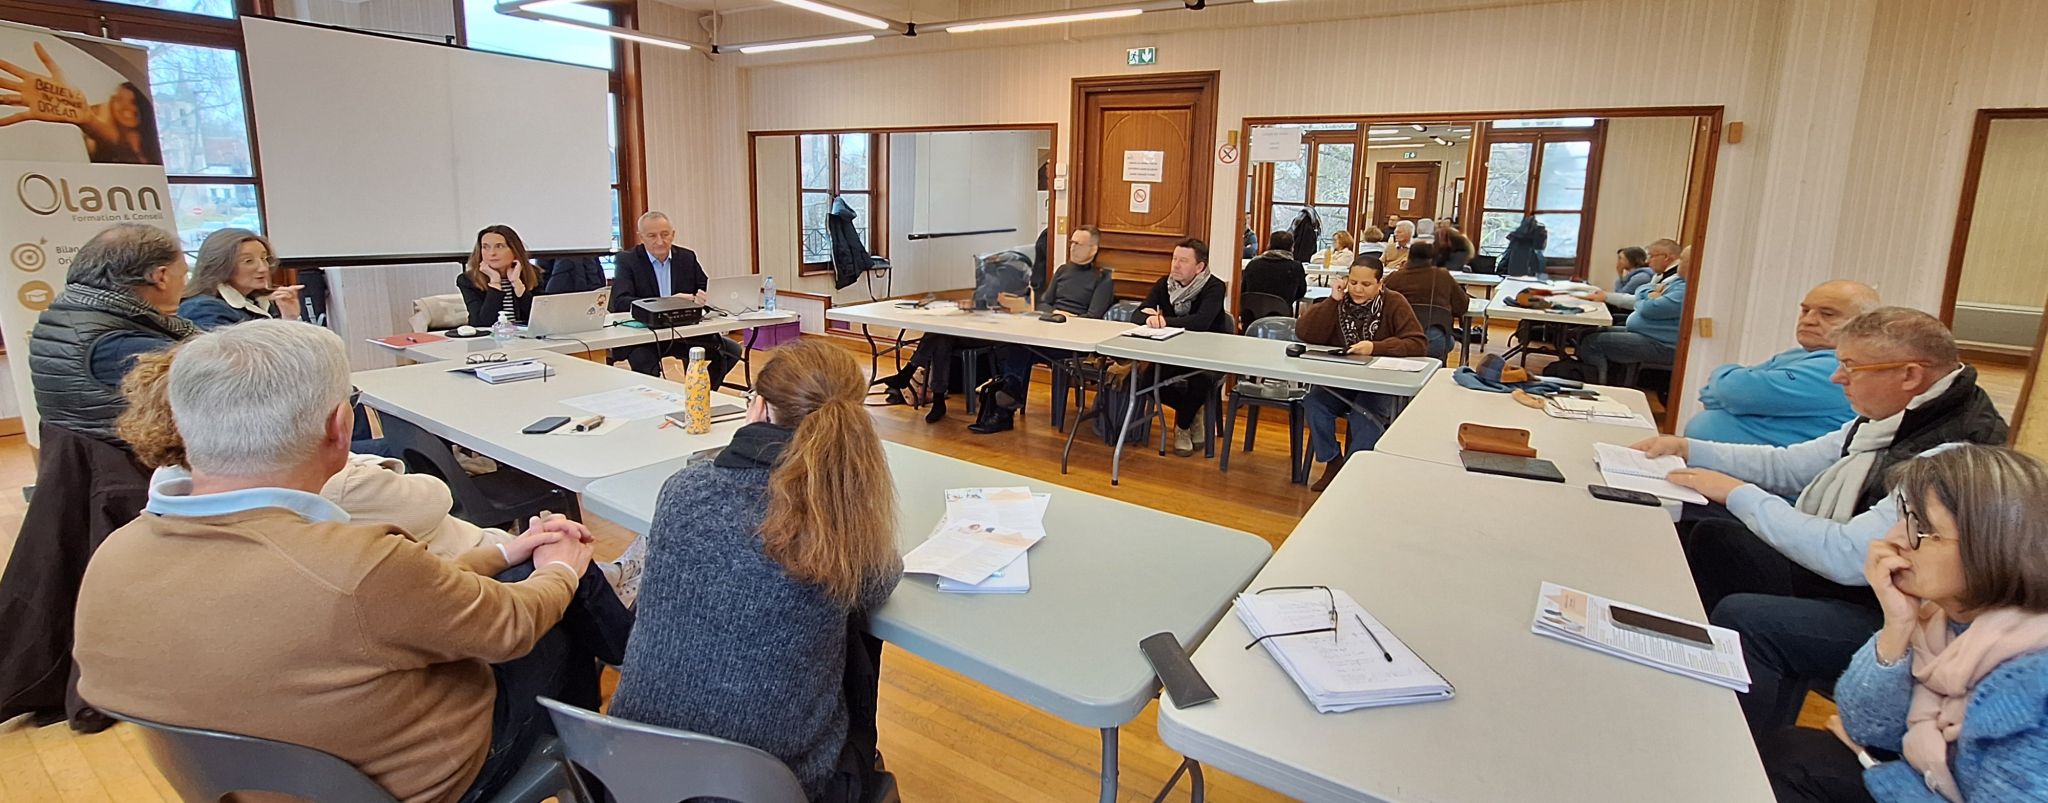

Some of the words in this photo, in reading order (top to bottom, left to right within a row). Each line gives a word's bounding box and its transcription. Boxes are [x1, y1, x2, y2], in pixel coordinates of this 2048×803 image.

[17, 172, 161, 215] Olann
[72, 213, 121, 222] Formation
[56, 246, 79, 254] Bilan
